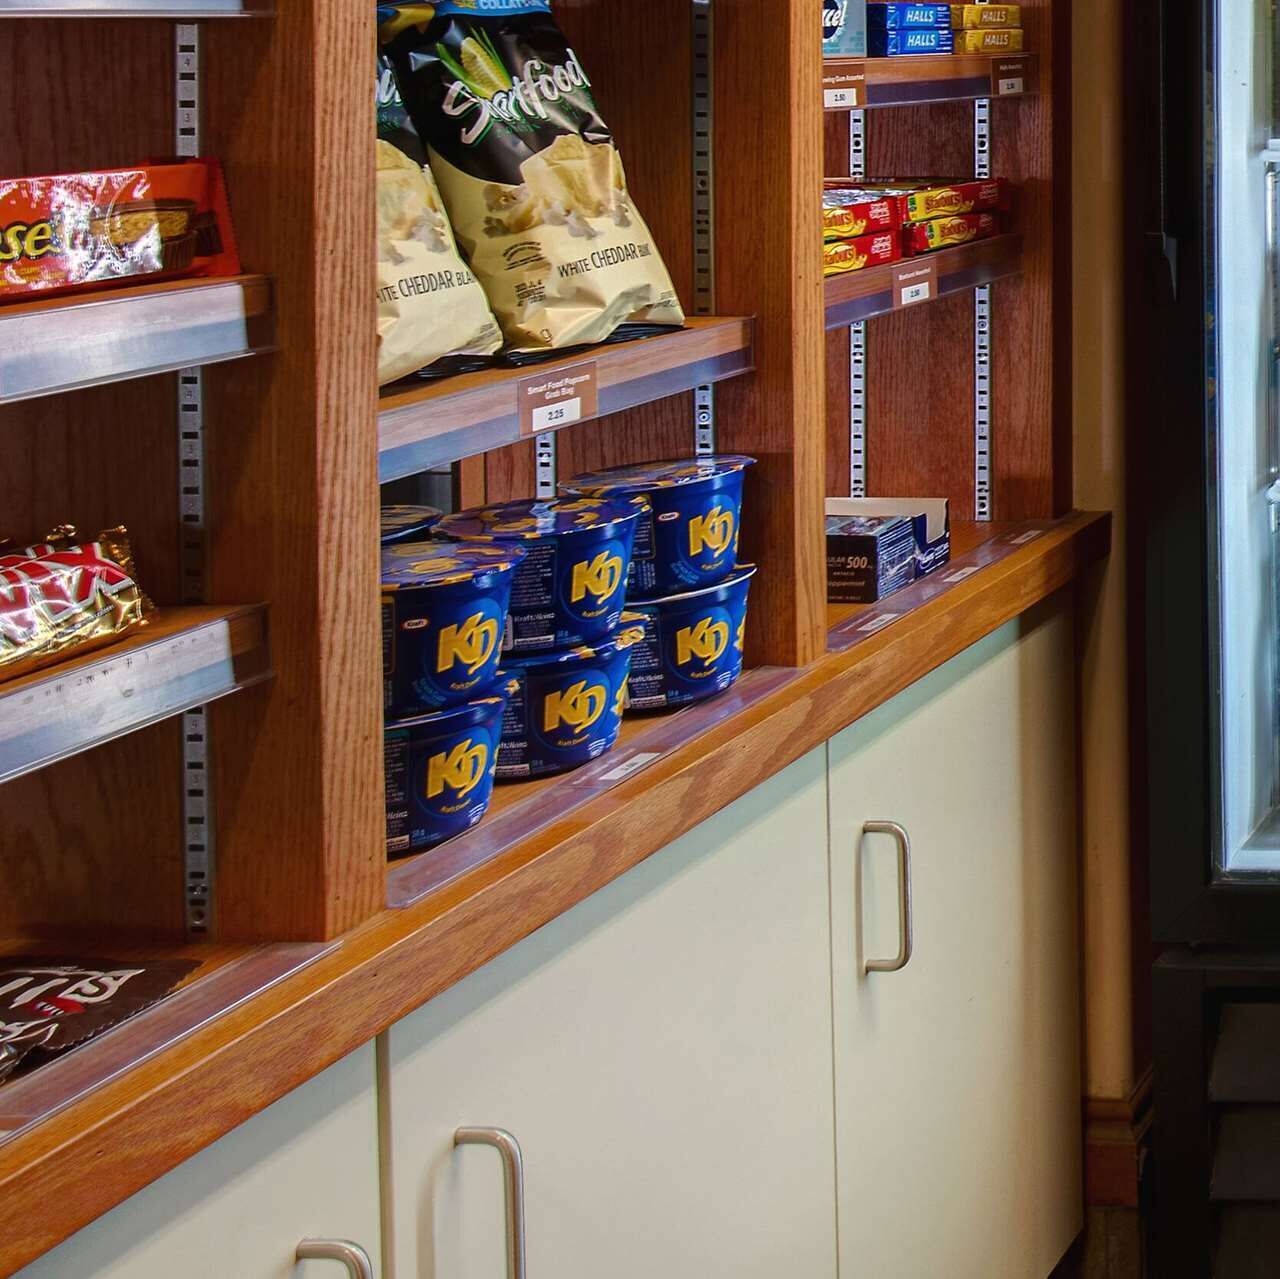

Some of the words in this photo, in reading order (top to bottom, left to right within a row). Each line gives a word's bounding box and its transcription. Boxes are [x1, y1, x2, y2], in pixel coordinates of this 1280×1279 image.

[905, 9, 934, 23] HALLS
[907, 33, 936, 47] HALLS
[981, 10, 1007, 23] HALLS
[983, 34, 1009, 46] HALLS
[442, 48, 592, 146] Smartfood
[398, 270, 455, 298] CHEDDAR
[557, 254, 592, 279] WHITE
[592, 242, 639, 270] CHEDDAR
[689, 504, 736, 558] KD
[571, 549, 624, 605] KD
[437, 611, 499, 675] KD
[677, 615, 730, 668] KD
[544, 679, 607, 736] KD
[426, 738, 488, 801] KD
